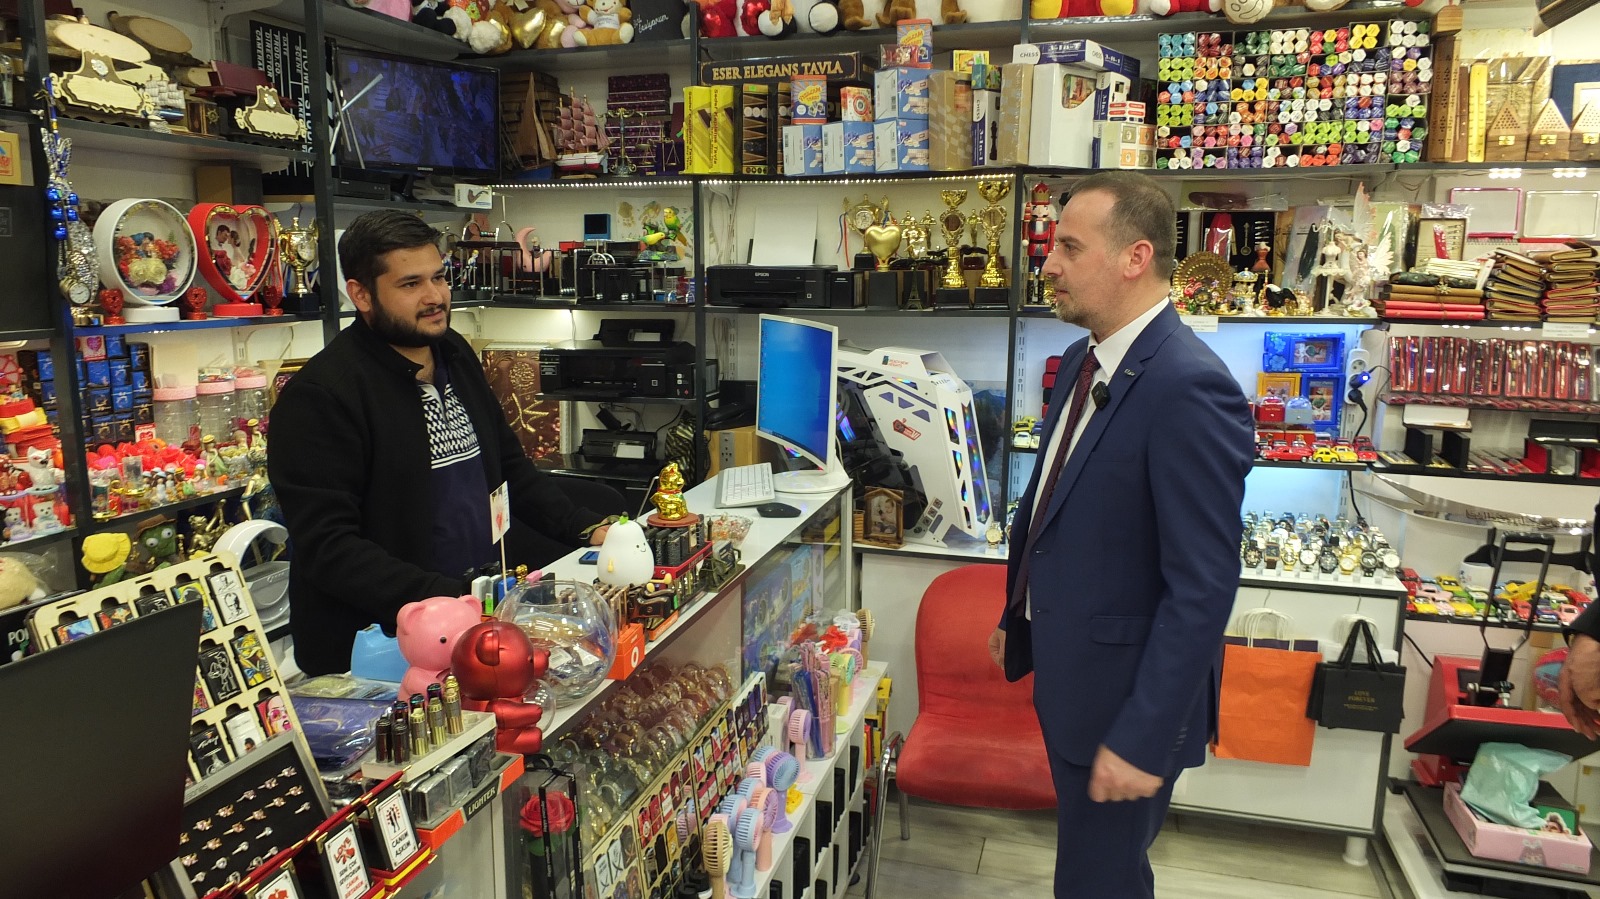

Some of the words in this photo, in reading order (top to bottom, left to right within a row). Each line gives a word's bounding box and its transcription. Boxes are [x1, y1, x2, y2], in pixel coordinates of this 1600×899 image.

[264, 32, 272, 78] DIRECTOR
[712, 67, 742, 80] ESER
[744, 62, 799, 78] ELEGANS
[801, 60, 844, 76] TAVLA
[468, 786, 496, 815] LIGHTER
[334, 836, 351, 864] LOVE
[392, 831, 409, 848] CANIM
